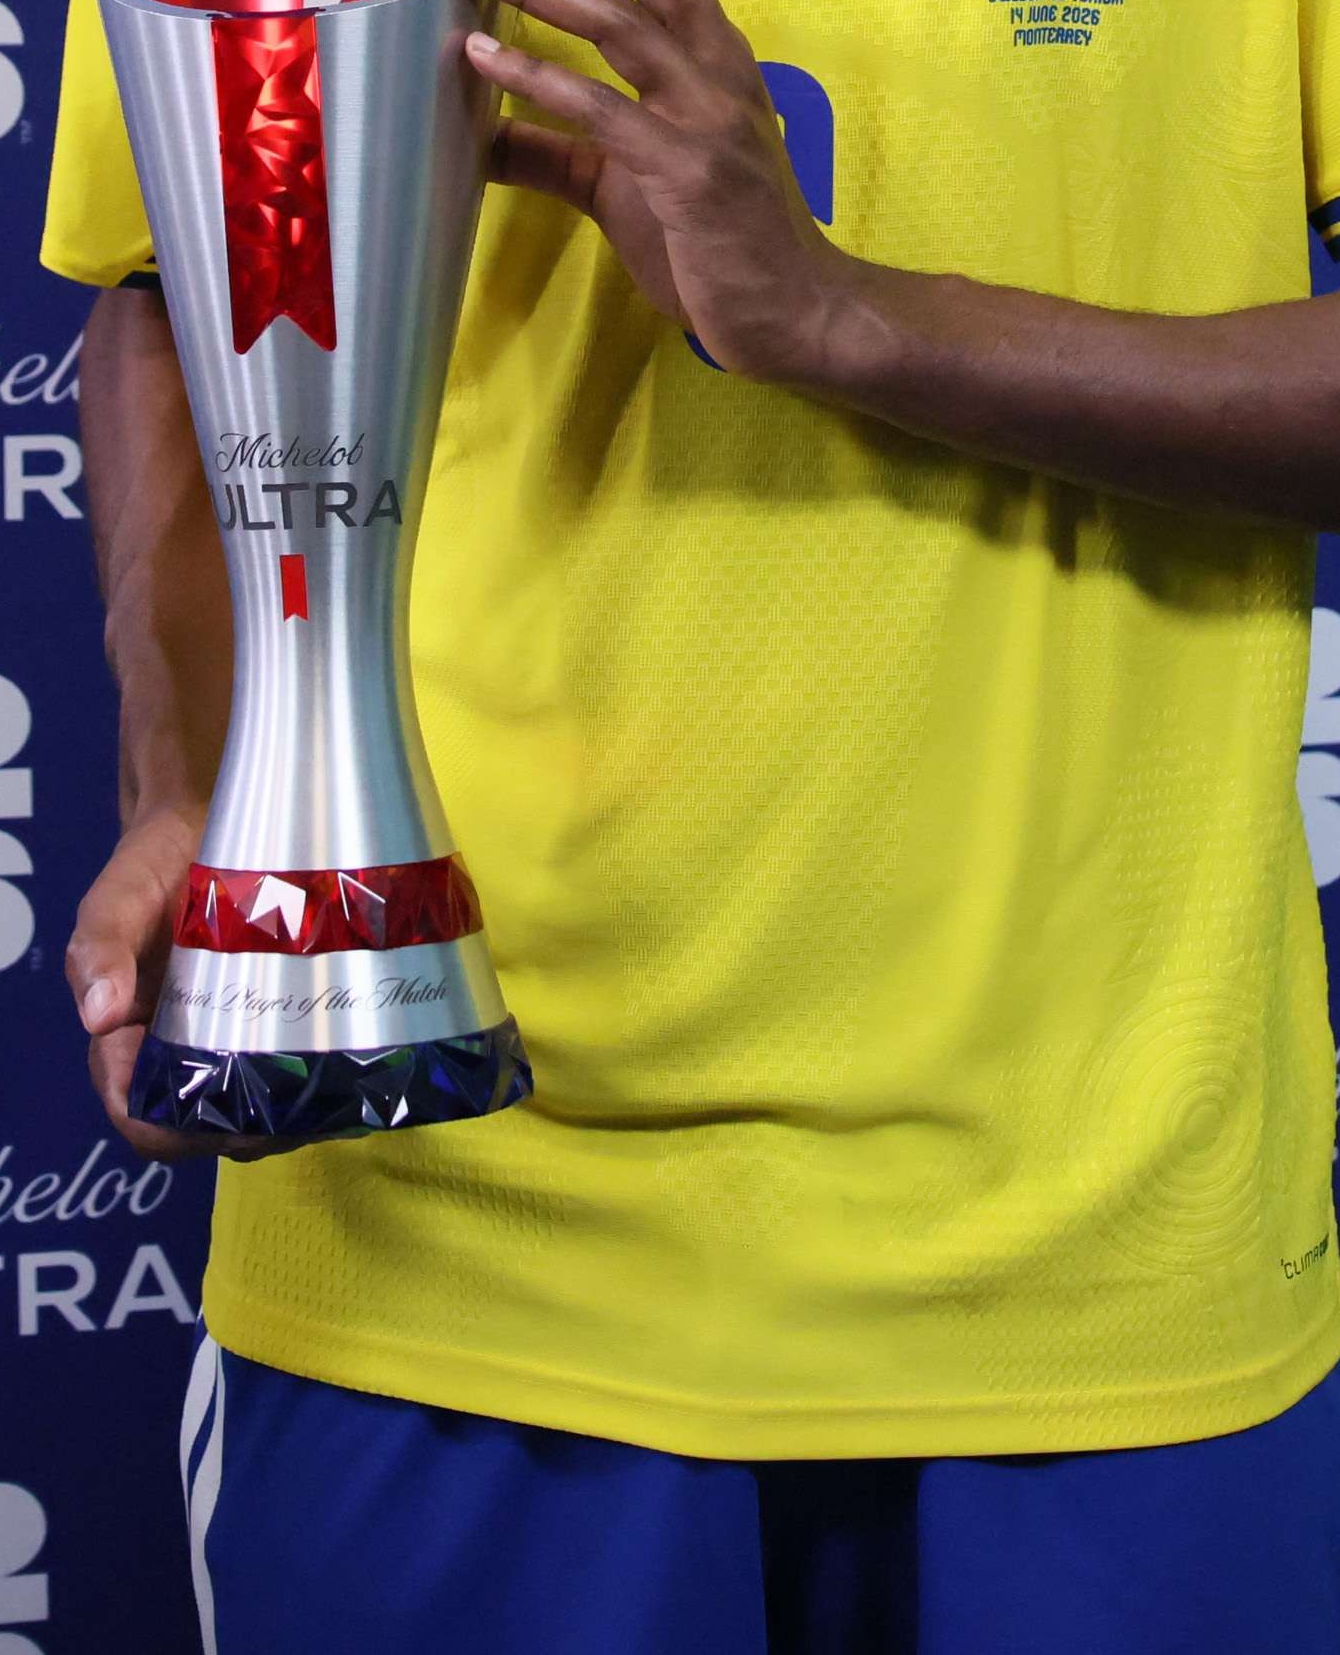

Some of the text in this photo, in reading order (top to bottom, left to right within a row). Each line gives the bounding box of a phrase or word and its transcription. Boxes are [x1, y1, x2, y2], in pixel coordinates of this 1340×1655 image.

[1010, 5, 1101, 26] 14 JUNE 2026
[1013, 26, 1093, 47] MONTERREY
[215, 432, 366, 473] Michelob
[210, 479, 403, 532] ULTRA
